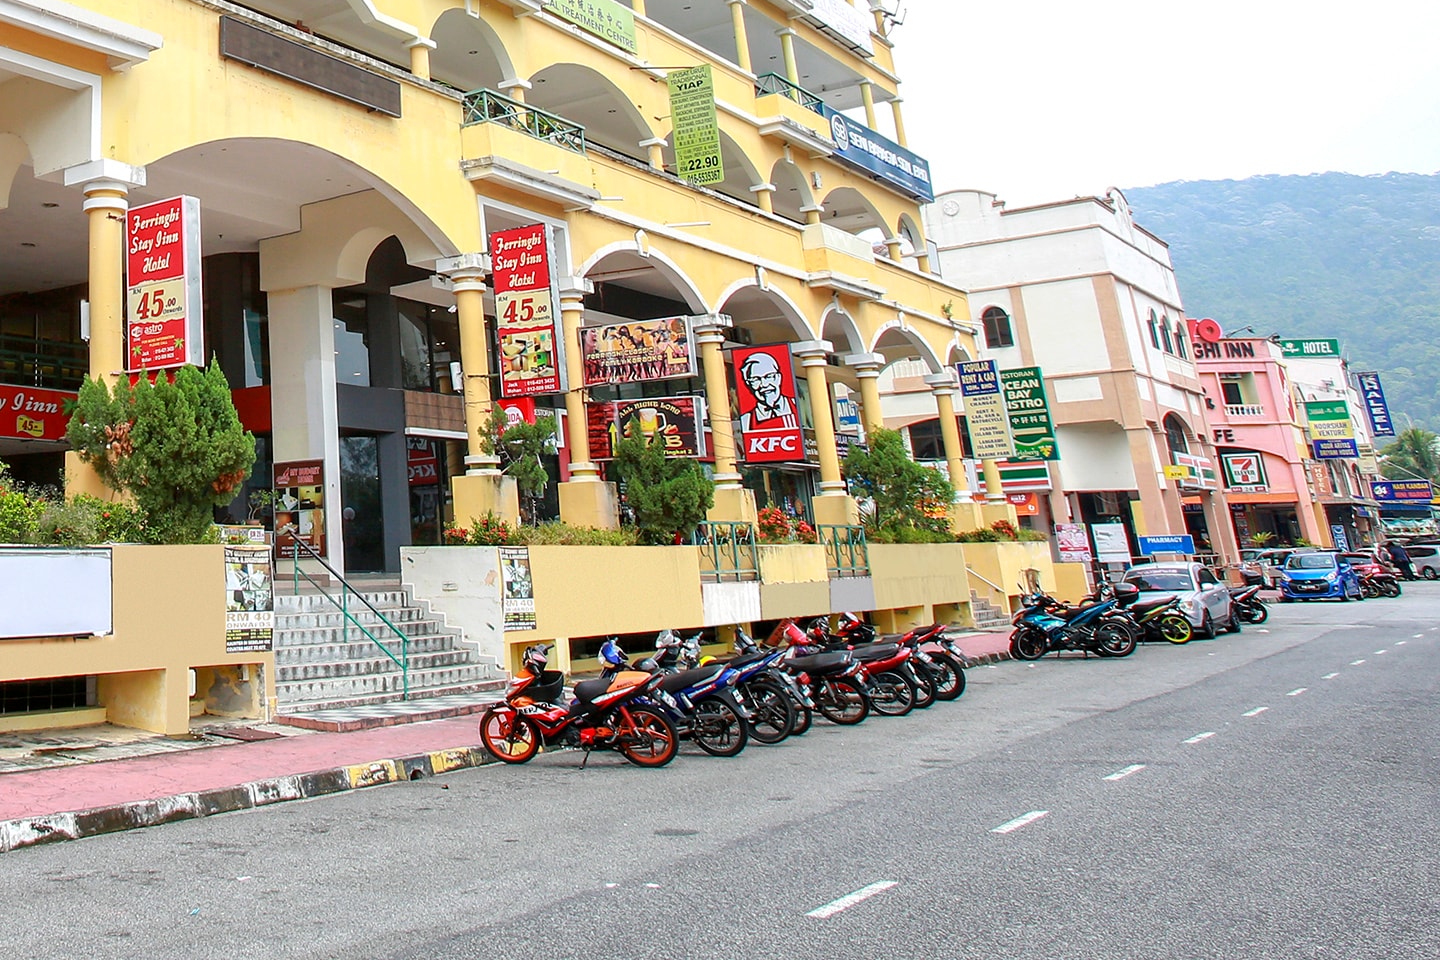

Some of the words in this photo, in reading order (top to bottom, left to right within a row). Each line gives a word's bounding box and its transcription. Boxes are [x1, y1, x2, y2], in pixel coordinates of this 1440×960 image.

[561, 4, 605, 34] TREATMENT
[606, 27, 635, 50] CENTRE
[676, 80, 704, 91] YIAP
[687, 155, 719, 171] 22.90
[131, 207, 180, 235] Ferringhi
[130, 236, 154, 254] Stay
[495, 232, 542, 254] Ferringhi
[142, 252, 171, 274] Hotel
[495, 255, 518, 271] Stay
[508, 271, 536, 288] Hotel
[144, 323, 163, 335] astro
[1193, 342, 1222, 359] GHI
[1224, 341, 1255, 358] INN
[1302, 341, 1333, 354] HOTEL
[963, 361, 990, 374] POPULAR
[1001, 370, 1034, 380] ESTORAN
[961, 374, 976, 385] RENT
[983, 371, 996, 382] CAR
[1007, 389, 1031, 400] BAY
[1006, 398, 1044, 410] ISTRO
[748, 435, 797, 455] KFC
[1146, 536, 1184, 544] PHARMACY
[226, 613, 250, 622] RM
[253, 613, 272, 622] 40
